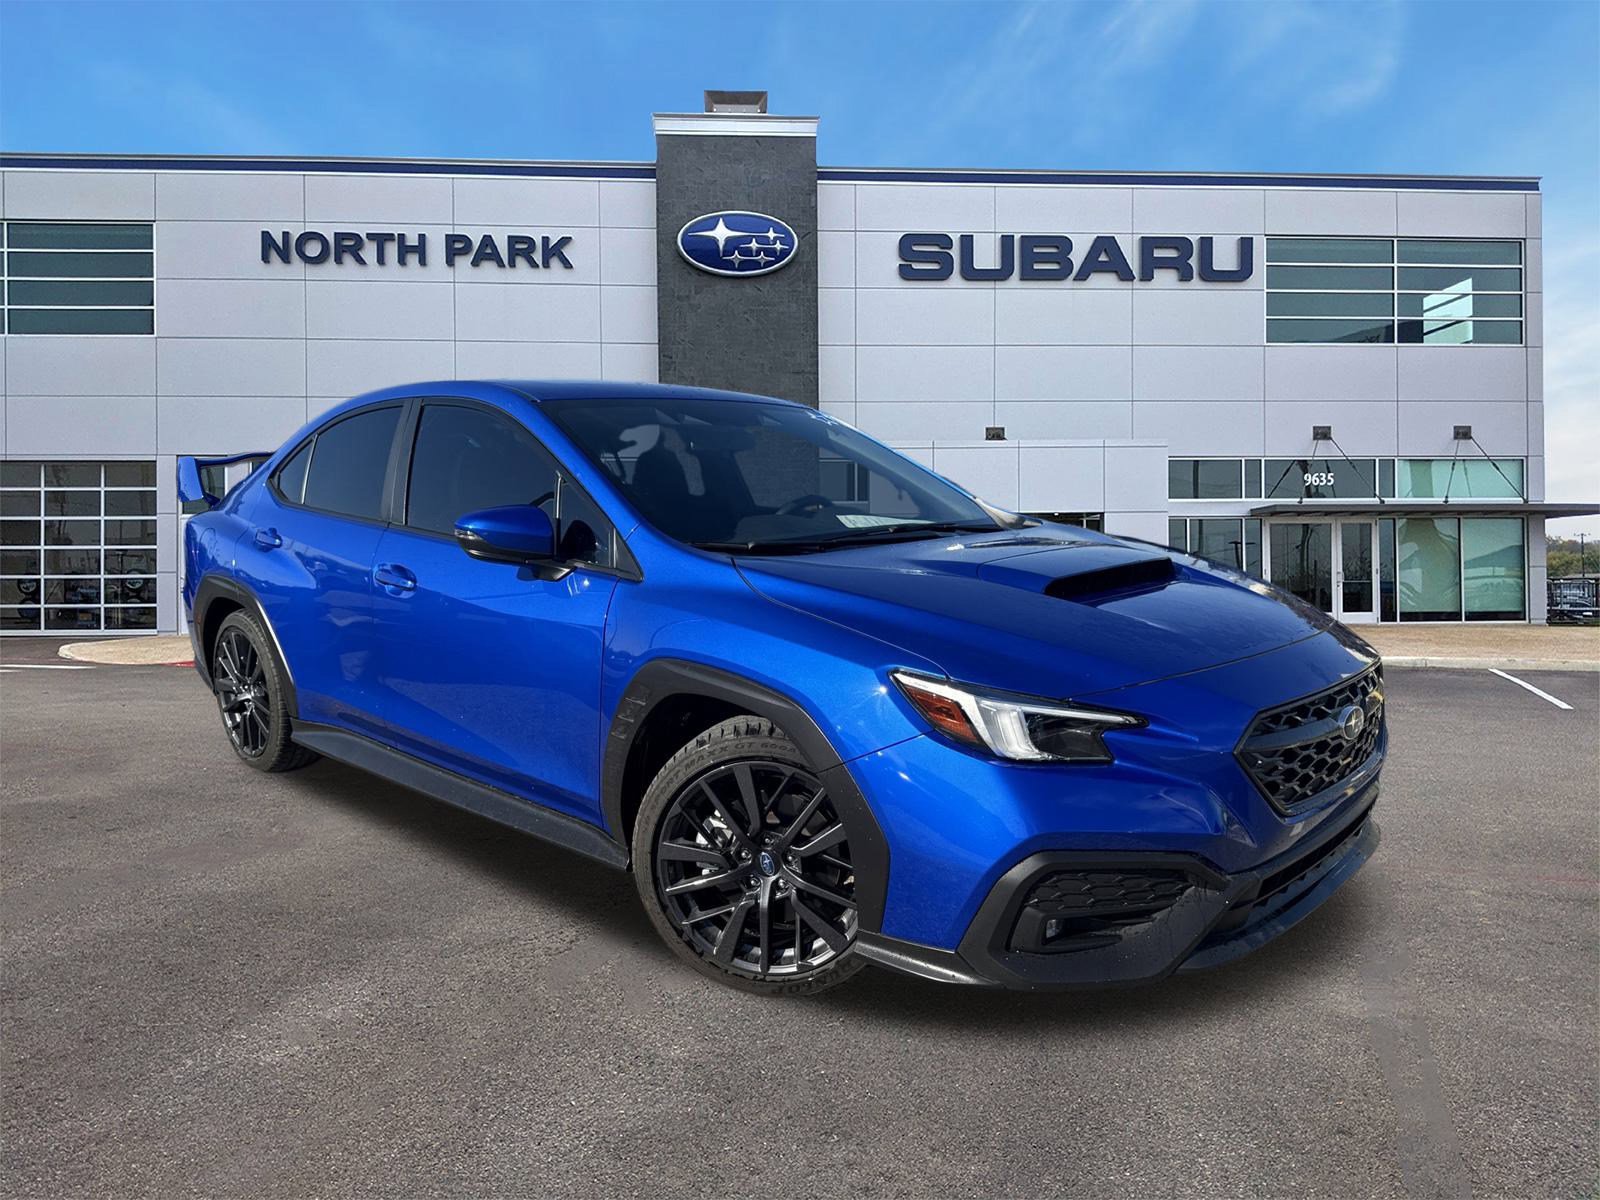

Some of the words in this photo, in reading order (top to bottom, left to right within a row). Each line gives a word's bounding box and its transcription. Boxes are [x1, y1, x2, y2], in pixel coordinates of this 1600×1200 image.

[260, 230, 428, 266] NORTH
[445, 233, 574, 269] PARK
[898, 233, 1254, 282] SUBARU
[1304, 472, 1335, 486] 9635
[683, 744, 729, 773] MAXX
[734, 741, 755, 750] GT
